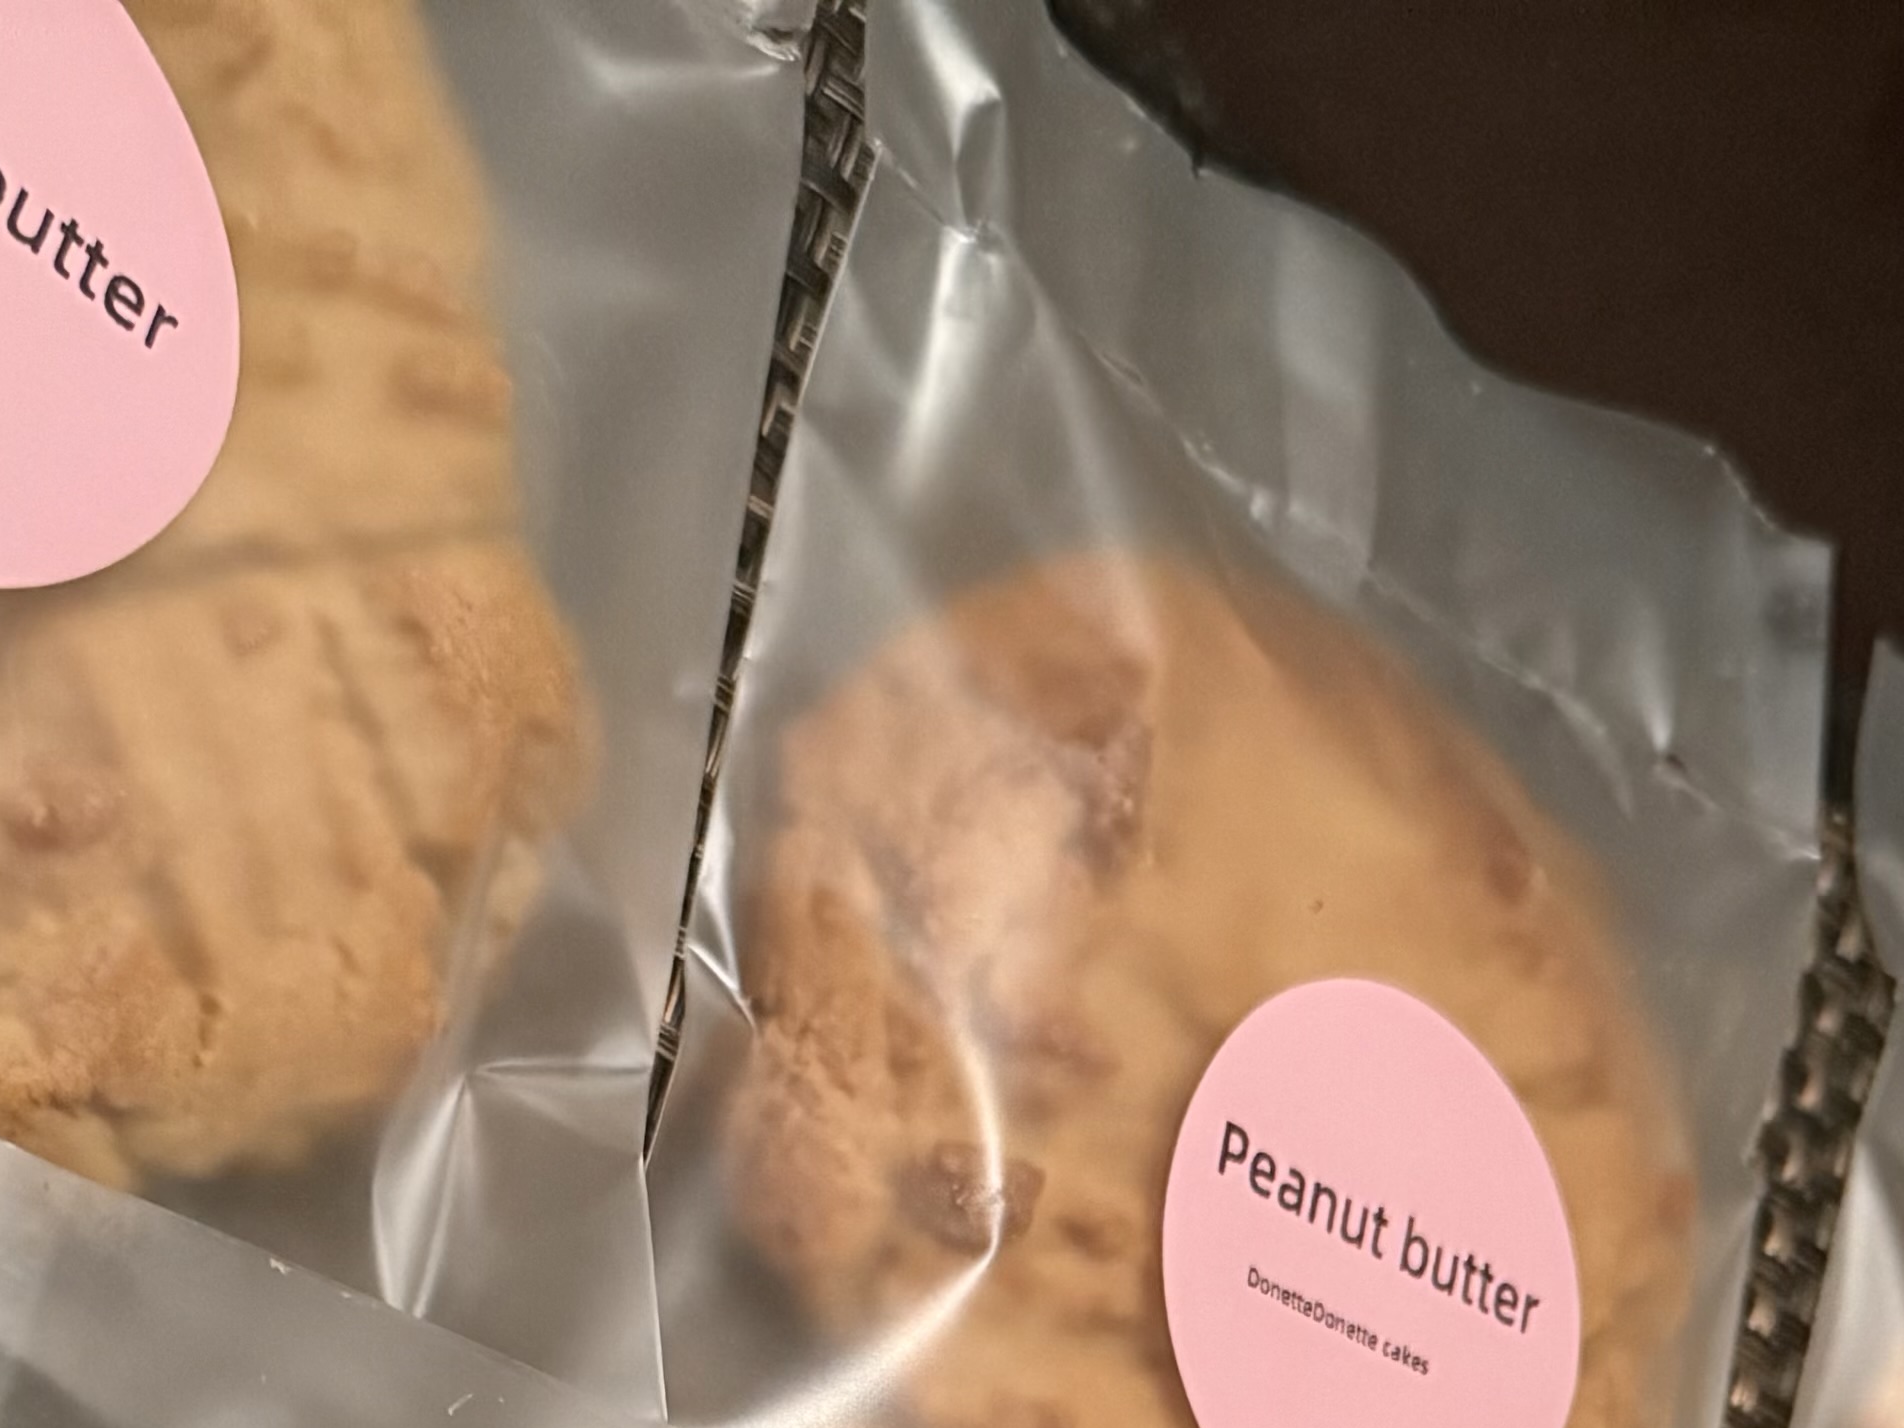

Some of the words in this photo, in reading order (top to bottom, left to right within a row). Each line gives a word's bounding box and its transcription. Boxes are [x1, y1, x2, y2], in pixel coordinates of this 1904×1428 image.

[1219, 1121, 1388, 1259] Peanut
[1400, 1216, 1539, 1333] butter
[1248, 1267, 1378, 1350] DonetteDonette
[1383, 1342, 1428, 1375] cakes
